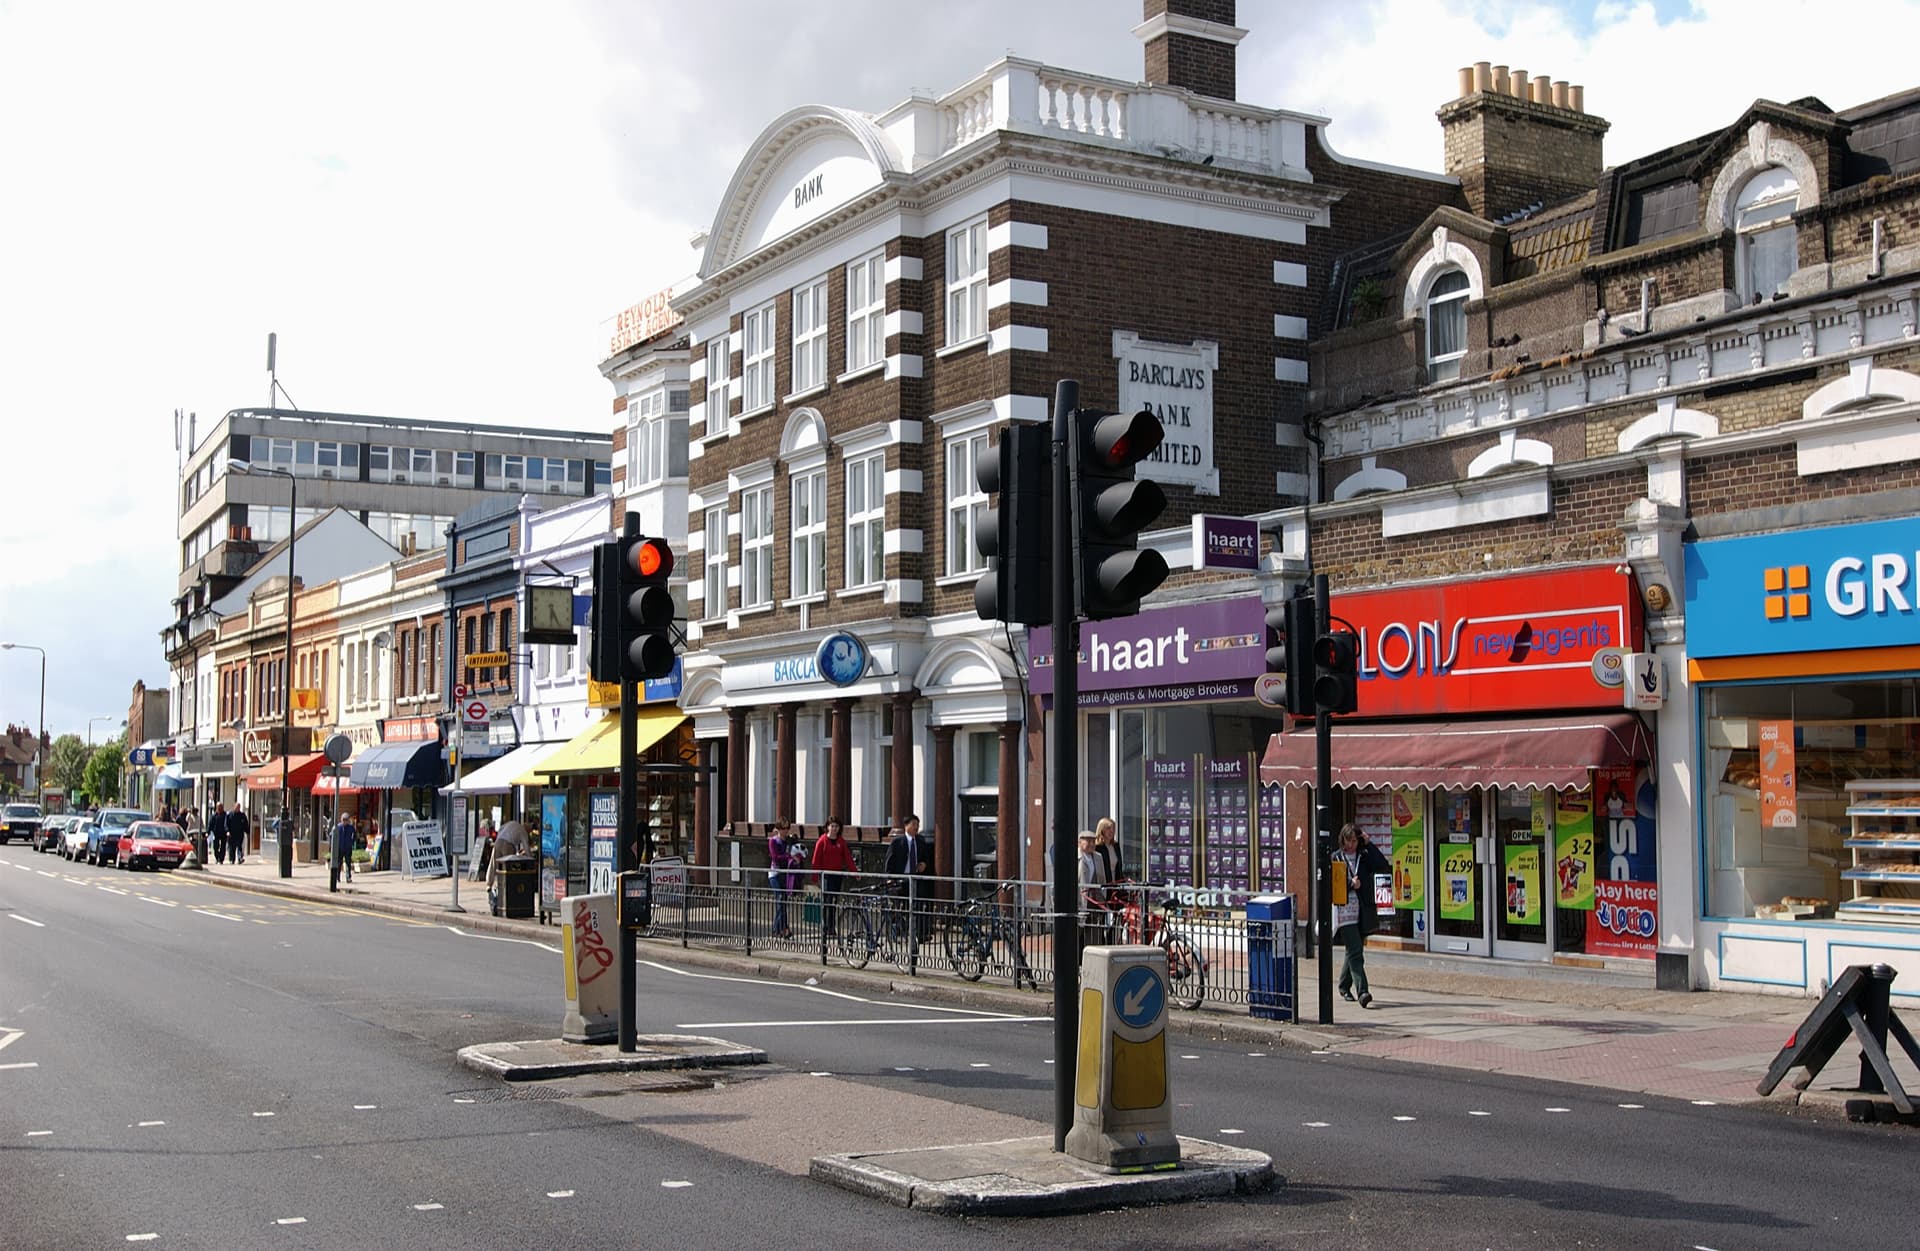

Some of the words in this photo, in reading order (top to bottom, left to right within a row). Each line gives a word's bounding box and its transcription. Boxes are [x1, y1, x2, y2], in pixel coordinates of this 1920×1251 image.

[795, 174, 823, 208] BANK
[1129, 361, 1205, 390] BARCLAYS
[1144, 442, 1202, 466] MITED
[1208, 530, 1254, 549] haart
[1474, 619, 1611, 656] newagents
[1091, 627, 1189, 673] haart
[1359, 617, 1466, 680] LONS
[774, 655, 822, 682] BARCLA
[1077, 693, 1100, 704] state
[1102, 690, 1135, 704] Agents
[1137, 690, 1146, 700] &
[1148, 686, 1195, 700] Mortgage
[1198, 683, 1238, 696] Brokers
[1154, 761, 1186, 773] haart
[1210, 760, 1241, 773] haart
[593, 798, 611, 811] DAILY
[592, 812, 617, 826] EXPRESS
[416, 836, 432, 846] THE
[1512, 831, 1532, 840] OPEN
[409, 846, 443, 858] LEATHER
[1572, 839, 1578, 855] 3
[1584, 839, 1592, 855] 2
[413, 858, 443, 869] CENTRE
[1445, 859, 1473, 873] £2.99
[1625, 882, 1657, 899] here
